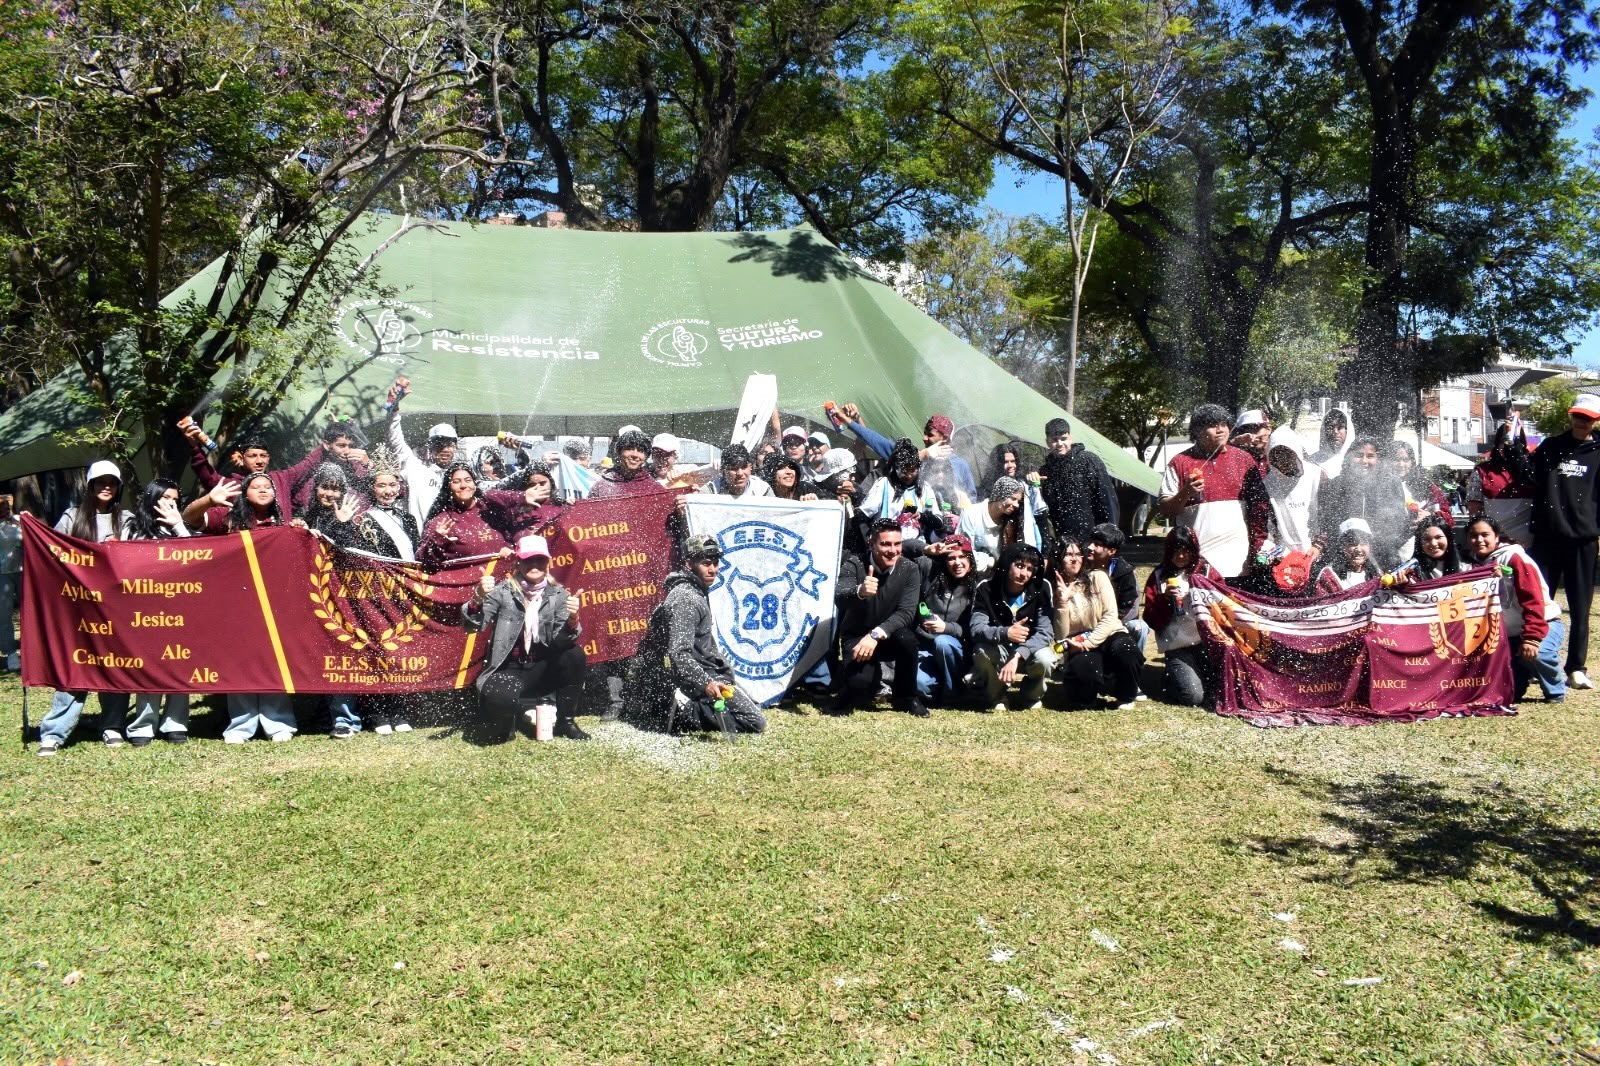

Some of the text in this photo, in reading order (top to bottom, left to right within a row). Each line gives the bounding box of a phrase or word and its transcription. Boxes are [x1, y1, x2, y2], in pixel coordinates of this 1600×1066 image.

[431, 328, 580, 346] Municipalidad de
[719, 324, 801, 343] CULTURA
[722, 329, 823, 352] Y TURISMO
[431, 338, 600, 360] Resistencia
[568, 520, 630, 543] Oriana
[733, 528, 787, 548] E.E.S.
[49, 545, 213, 567] Fabri Lopez
[581, 549, 648, 575] Antonio
[60, 578, 203, 602] Aylen Milagros
[579, 580, 657, 608] Florencio
[1422, 591, 1438, 604] 26
[742, 592, 780, 630] 28
[1449, 602, 1459, 620] 5
[77, 611, 185, 636] Axel Jesica
[607, 616, 648, 636] Elias
[1472, 623, 1481, 639] 2
[72, 645, 191, 669] Cardozo Ale
[323, 655, 373, 672] E.E.S.
[400, 656, 428, 671] 109
[1404, 657, 1431, 666] KIRA
[189, 667, 219, 684] Ale
[350, 672, 380, 687] Hugo
[1298, 681, 1342, 694] RAMIRO
[1372, 679, 1407, 689] MARCE
